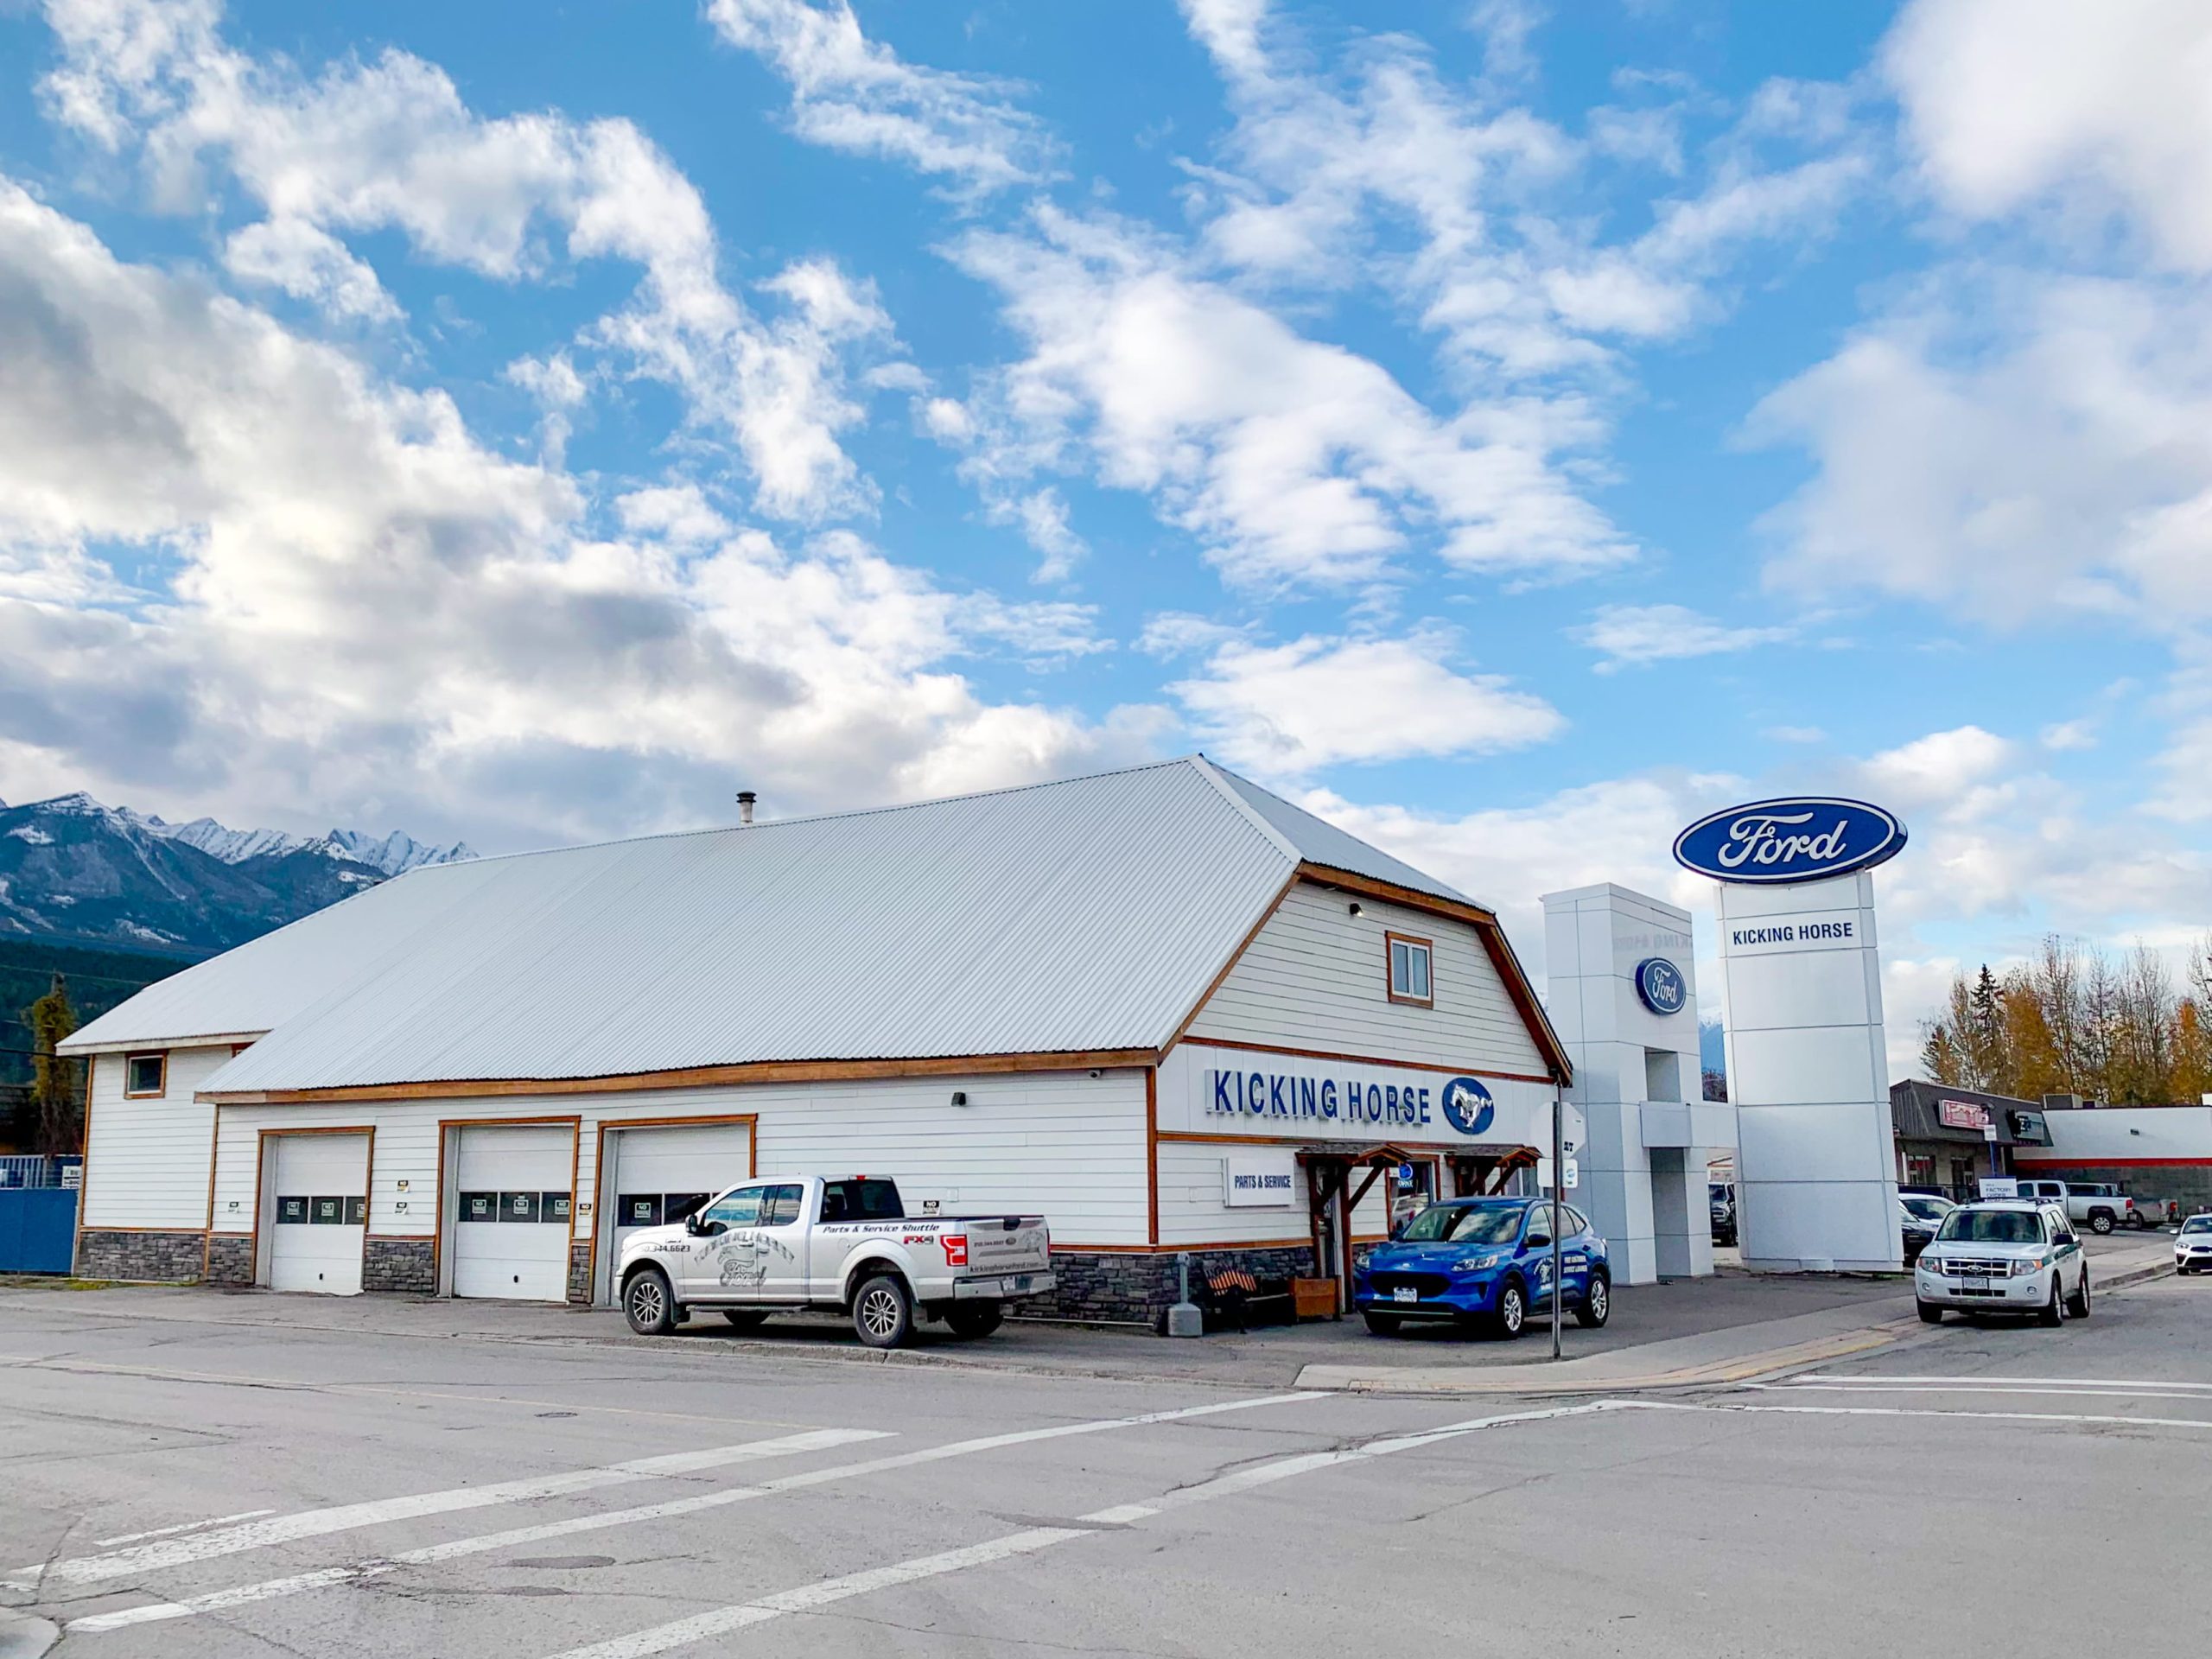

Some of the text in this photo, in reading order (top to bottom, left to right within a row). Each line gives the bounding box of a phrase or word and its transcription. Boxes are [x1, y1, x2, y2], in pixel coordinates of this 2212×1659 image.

[1718, 812, 1848, 868] Ford
[1733, 922, 1853, 945] KICKING HORSE
[1652, 967, 1678, 1004] Ford
[1214, 1070, 1432, 1123] KICKING HORSE
[1563, 1141, 1573, 1152] 27
[1235, 1175, 1291, 1189] PARTS & SERVICE
[720, 1259, 767, 1287] Ford
